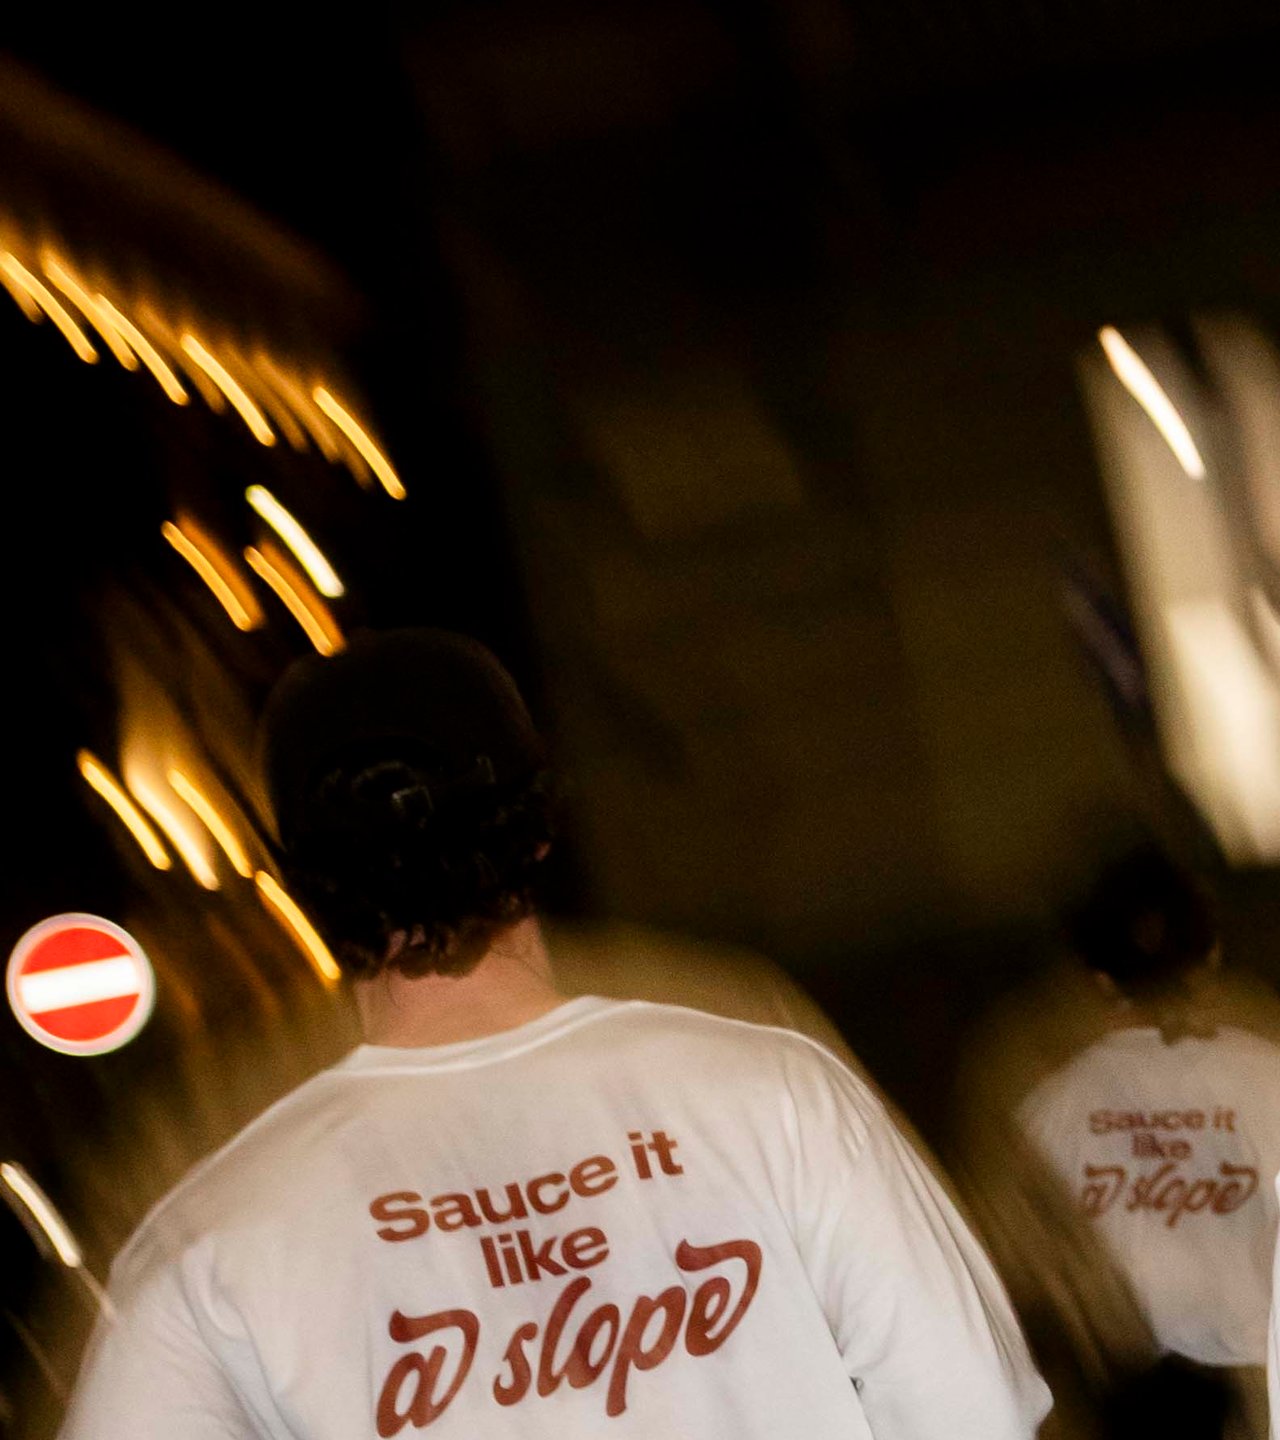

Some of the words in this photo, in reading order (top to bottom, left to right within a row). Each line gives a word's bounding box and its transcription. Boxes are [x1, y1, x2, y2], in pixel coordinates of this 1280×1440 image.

[369, 1153, 620, 1243] Sauce
[627, 1130, 684, 1180] it
[480, 1226, 610, 1288] like
[376, 1308, 480, 1439] a
[492, 1238, 763, 1417] slope
